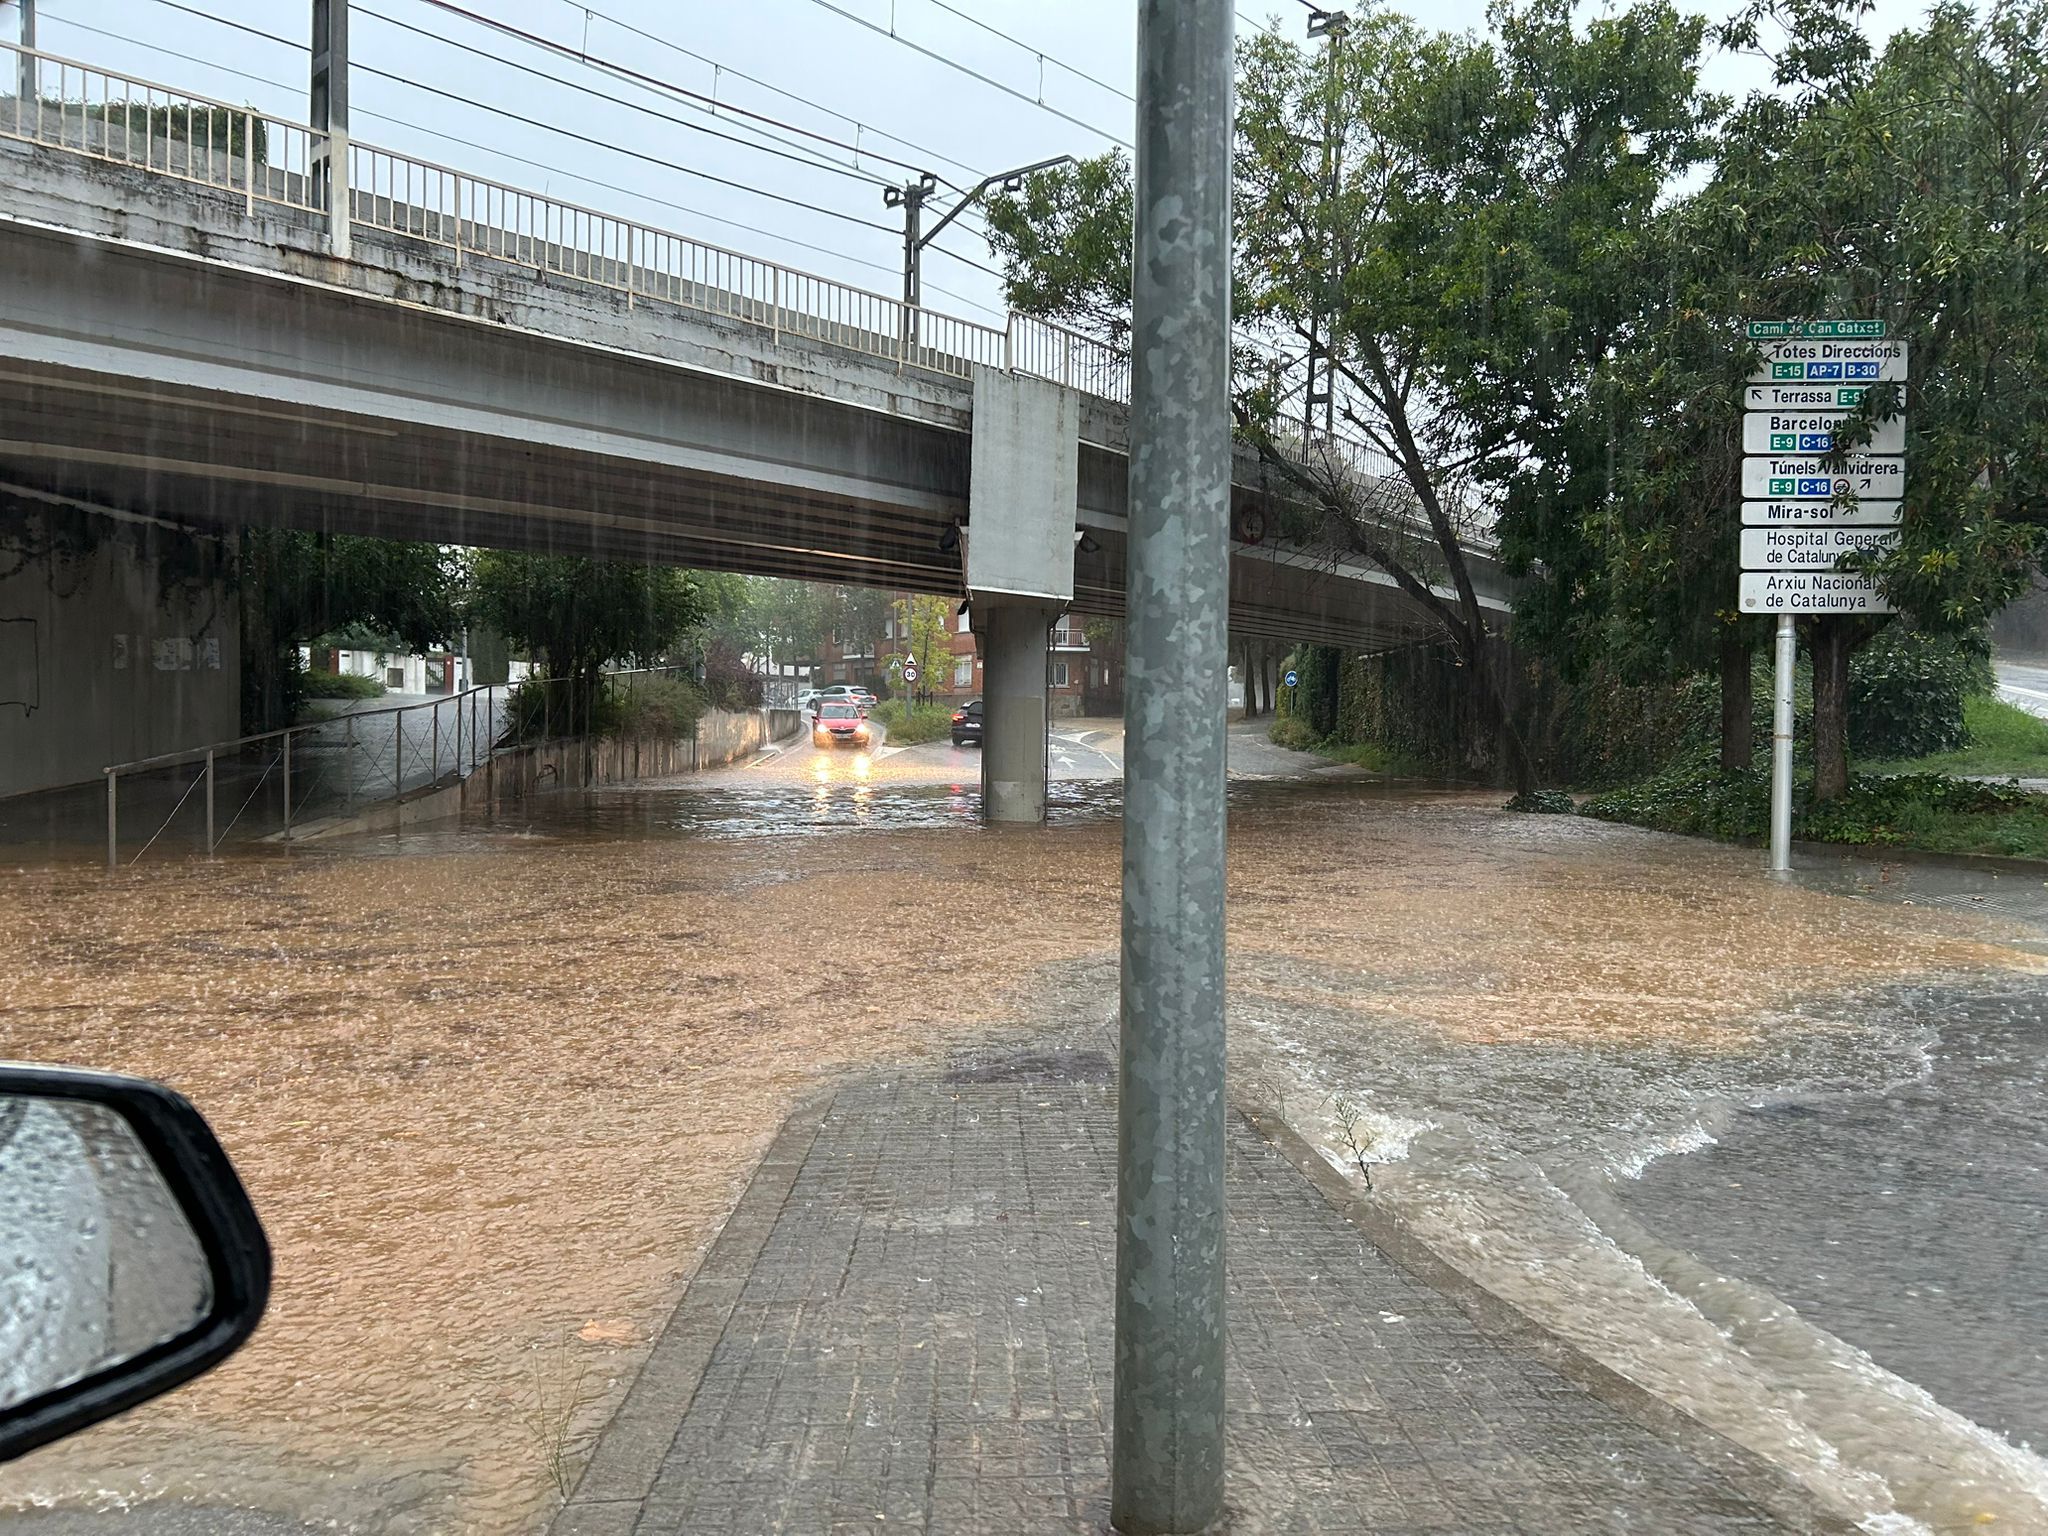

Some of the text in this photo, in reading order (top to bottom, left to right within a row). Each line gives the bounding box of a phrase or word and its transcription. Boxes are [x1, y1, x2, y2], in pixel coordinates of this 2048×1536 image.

[1753, 322, 1783, 334] Camí
[1808, 323, 1832, 333] Can
[1773, 344, 1900, 359] Totes Direccions
[1775, 365, 1877, 376] E-15 AP-7 B-30
[1772, 389, 1861, 403] Terrassa E-9
[1773, 437, 1829, 448] E-9 C-16
[1770, 459, 1898, 475] Túnels Vallvidrera
[1772, 481, 1828, 492] E-9 C-16
[1768, 505, 1834, 519] Mira-sol
[1767, 531, 1892, 548] Hospital General
[1766, 549, 1782, 563] de
[1766, 576, 1876, 590] Arxiu Nacional
[1766, 593, 1866, 610] de Catalunya
